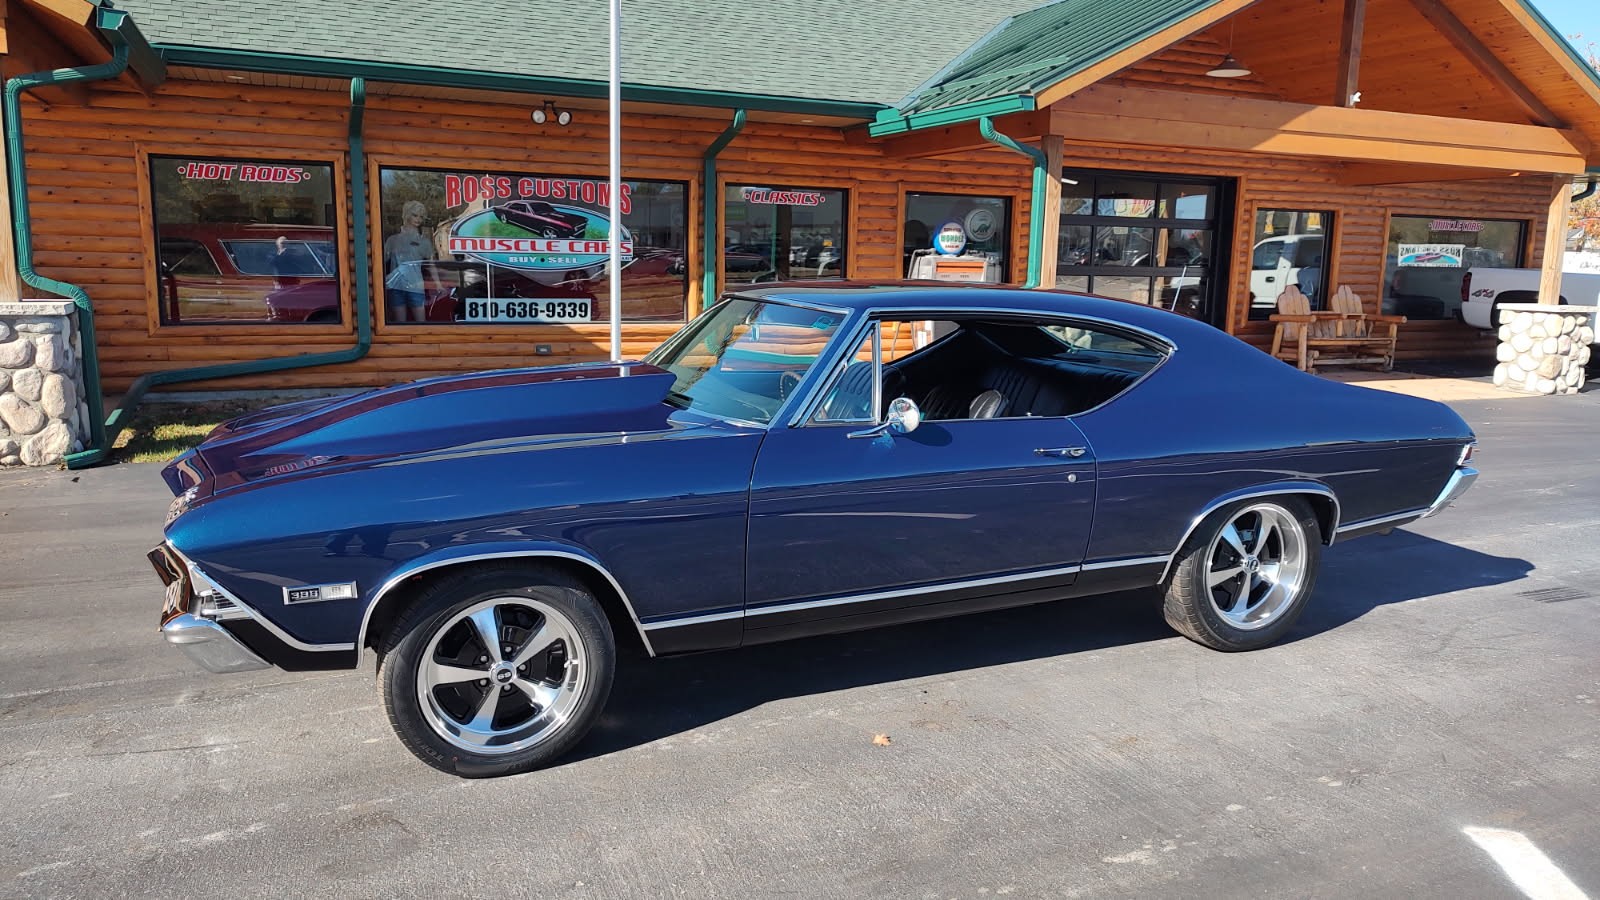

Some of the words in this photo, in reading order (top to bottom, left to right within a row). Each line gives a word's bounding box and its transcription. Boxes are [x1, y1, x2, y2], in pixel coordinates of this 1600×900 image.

[186, 162, 237, 180] HOT
[239, 165, 302, 183] RODS
[445, 174, 511, 209] ROSS
[518, 178, 632, 215] CUSTOMS
[750, 190, 820, 206] CLASSICS
[449, 238, 560, 253] MUSCLE
[508, 256, 537, 264] BUY
[468, 301, 588, 319] 810-636-9339
